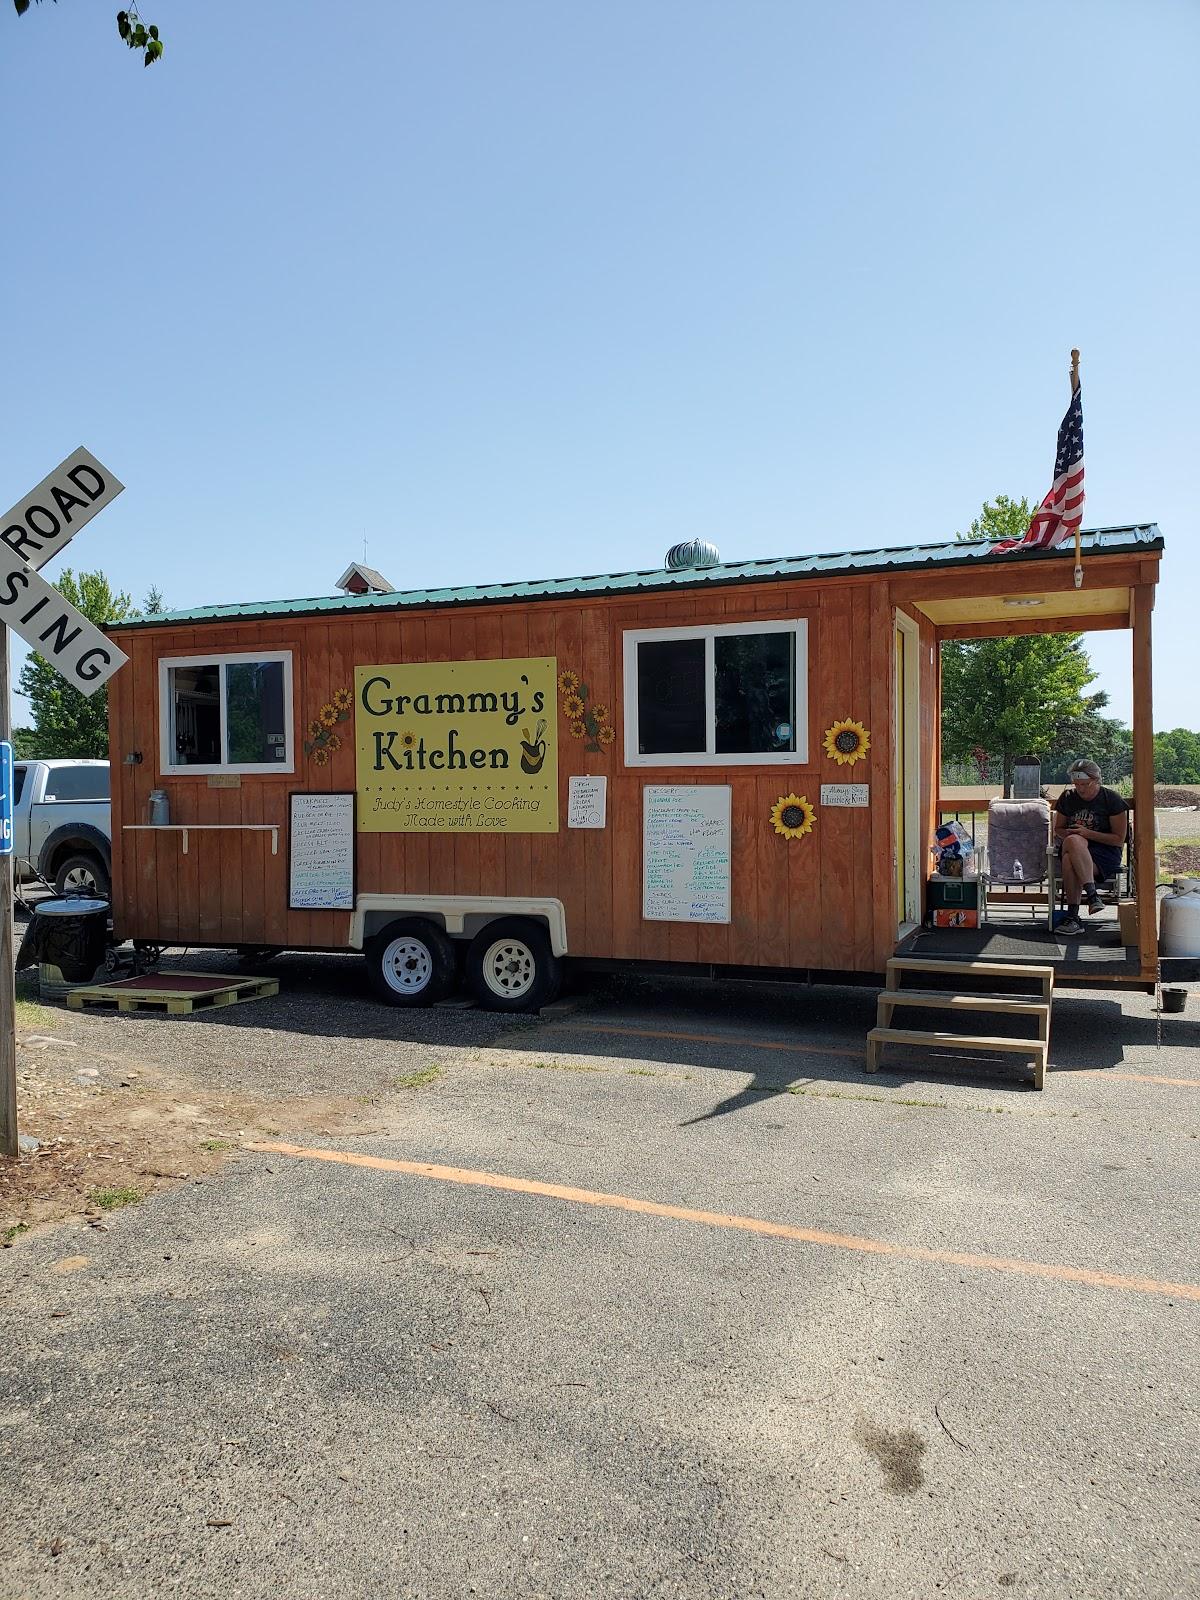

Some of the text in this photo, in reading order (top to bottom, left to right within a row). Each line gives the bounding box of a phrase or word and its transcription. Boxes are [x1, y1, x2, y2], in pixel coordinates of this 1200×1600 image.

[1, 464, 106, 562] ROAD
[361, 674, 545, 726] Grammy's
[372, 729, 509, 771] Kitchen
[372, 796, 541, 812] Judy's Homestyle Cooking
[403, 814, 508, 827] Made with Love
